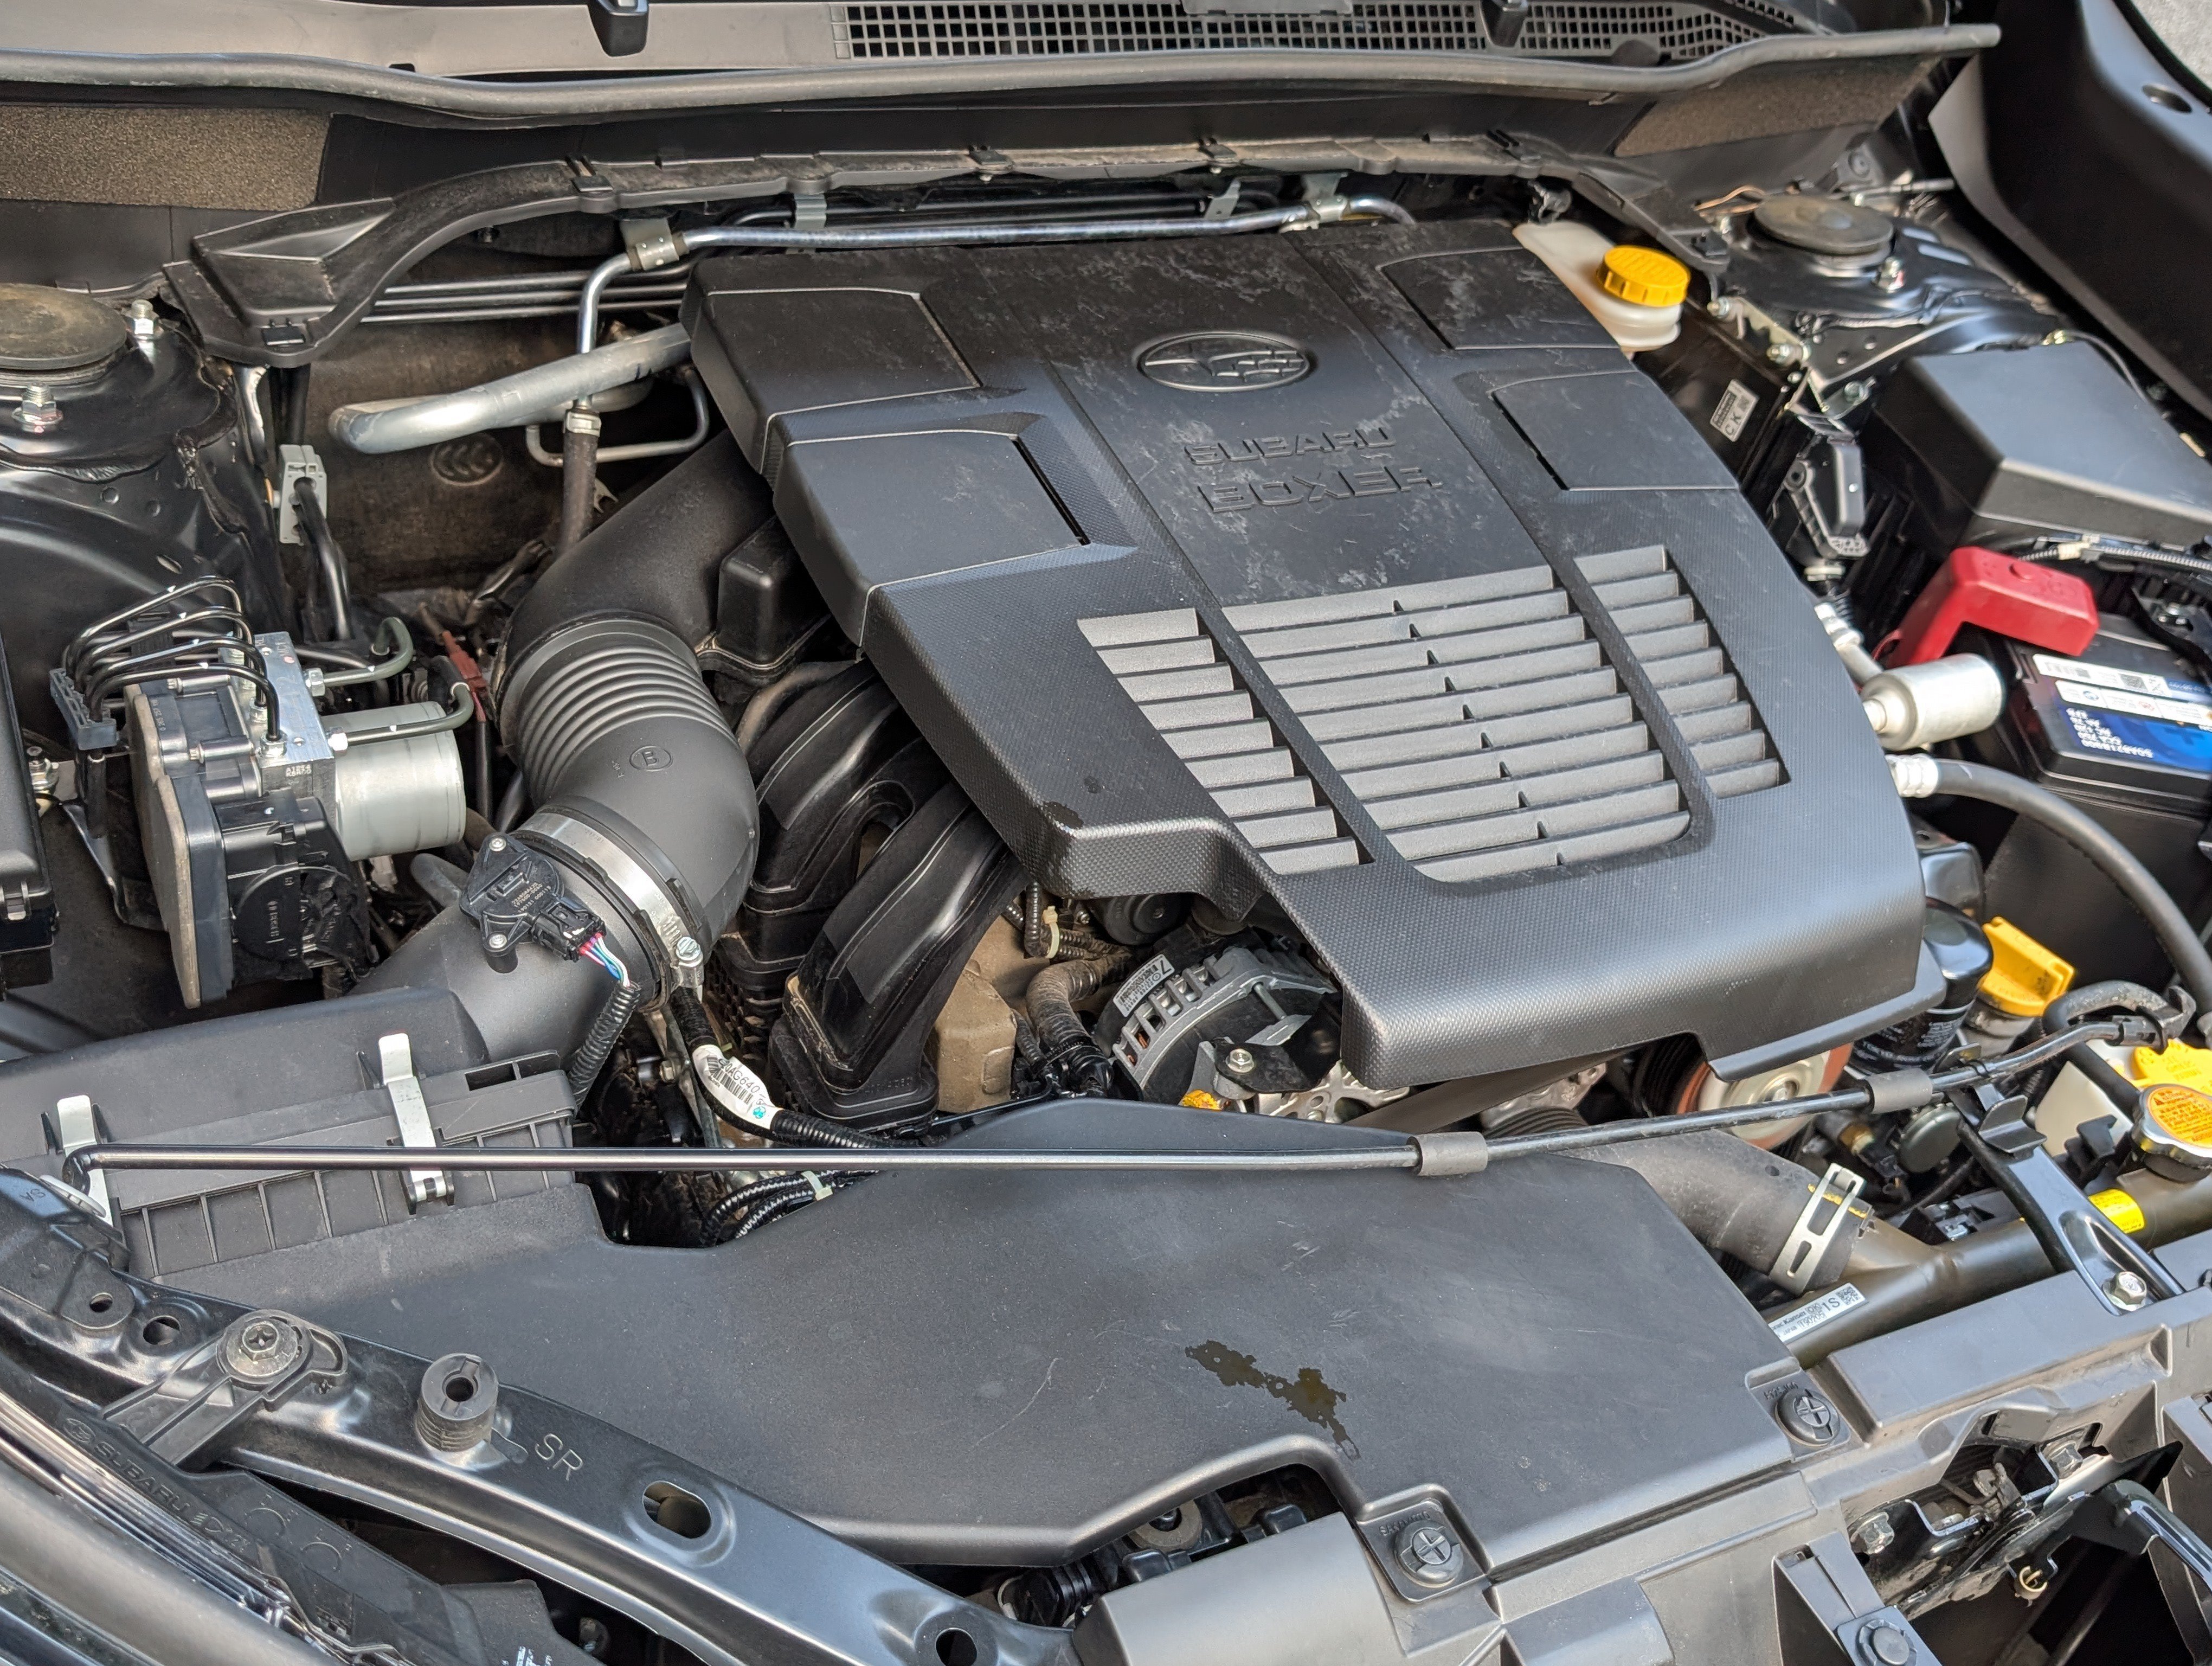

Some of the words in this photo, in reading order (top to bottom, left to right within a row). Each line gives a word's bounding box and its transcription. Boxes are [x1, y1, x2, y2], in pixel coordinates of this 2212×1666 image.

[1184, 427, 1397, 465] SUBARU
[1197, 466, 1443, 513] BOXER
[94, 1441, 191, 1514] SUBARU
[535, 1433, 583, 1482] SR
